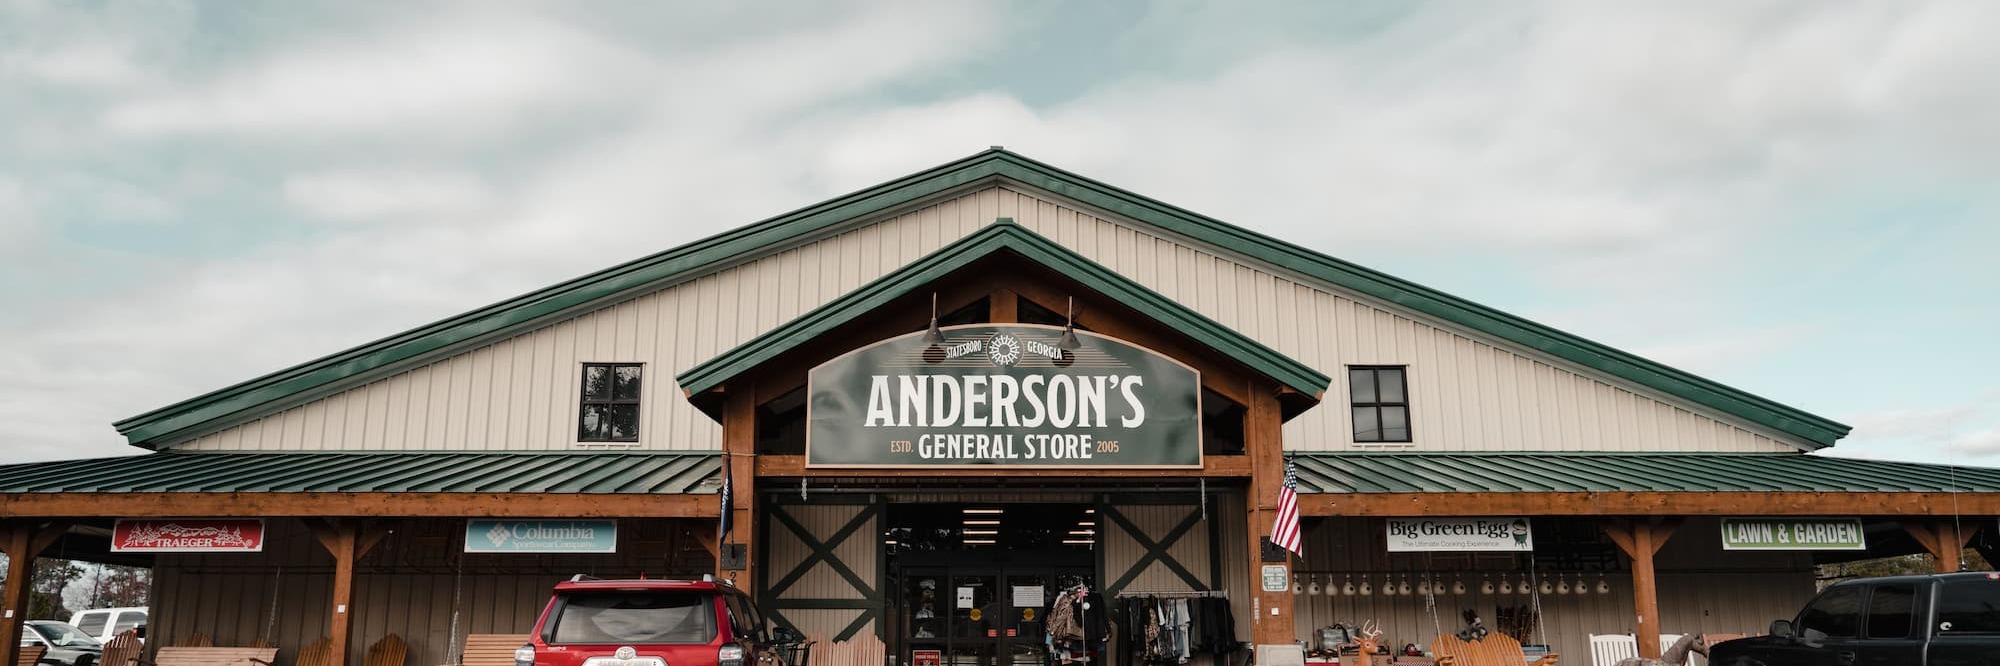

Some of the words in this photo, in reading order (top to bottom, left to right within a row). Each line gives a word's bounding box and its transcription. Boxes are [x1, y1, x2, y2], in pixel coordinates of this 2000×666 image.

[946, 340, 982, 358] STATESBORO
[1027, 341, 1063, 360] GEORGIA
[864, 374, 1145, 429] ANDERSON'S
[890, 441, 914, 453] ESTD.
[918, 434, 1018, 459] GENERAL
[1024, 434, 1092, 459] STORE
[1096, 441, 1120, 453] 2005
[511, 522, 594, 540] Columbia
[1390, 520, 1418, 539] Big
[1421, 520, 1474, 536] Green
[1477, 520, 1510, 539] Egg
[1728, 523, 1773, 544] LAWN
[1777, 523, 1790, 544] &
[1793, 523, 1858, 544] GARDEN
[156, 538, 213, 547] TRAEGER
